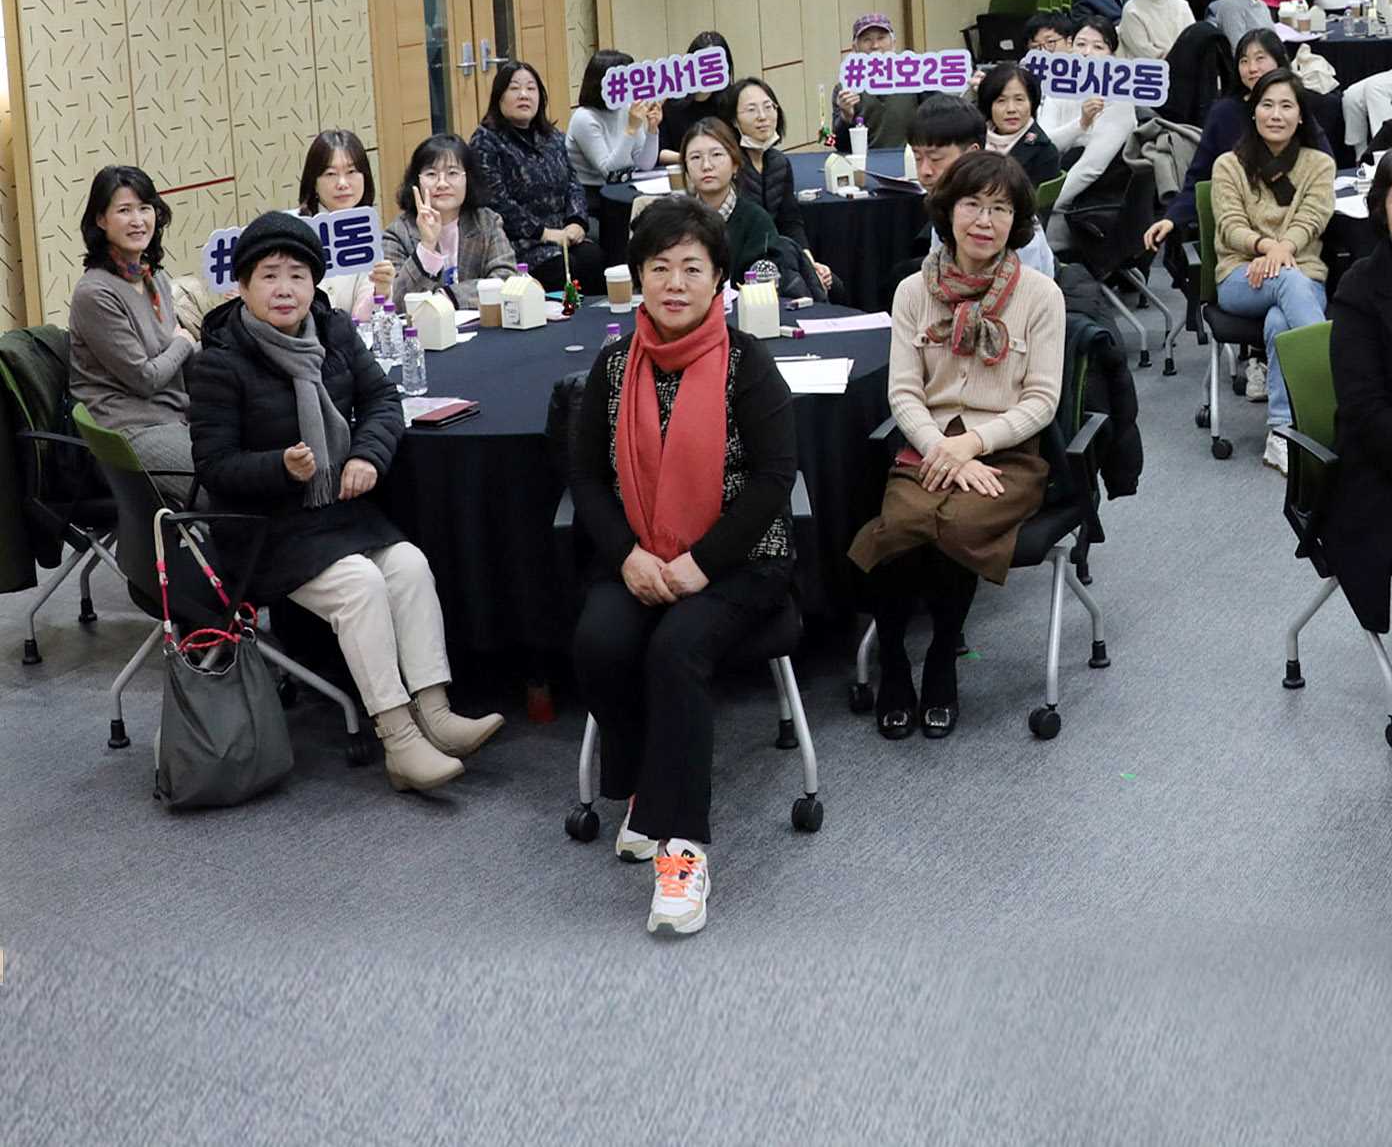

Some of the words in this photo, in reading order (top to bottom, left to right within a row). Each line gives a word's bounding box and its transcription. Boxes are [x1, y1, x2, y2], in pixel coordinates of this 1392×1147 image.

[607, 52, 725, 104] #암사1동
[844, 54, 968, 89] #천호2동
[1025, 56, 1164, 101] #암사2동
